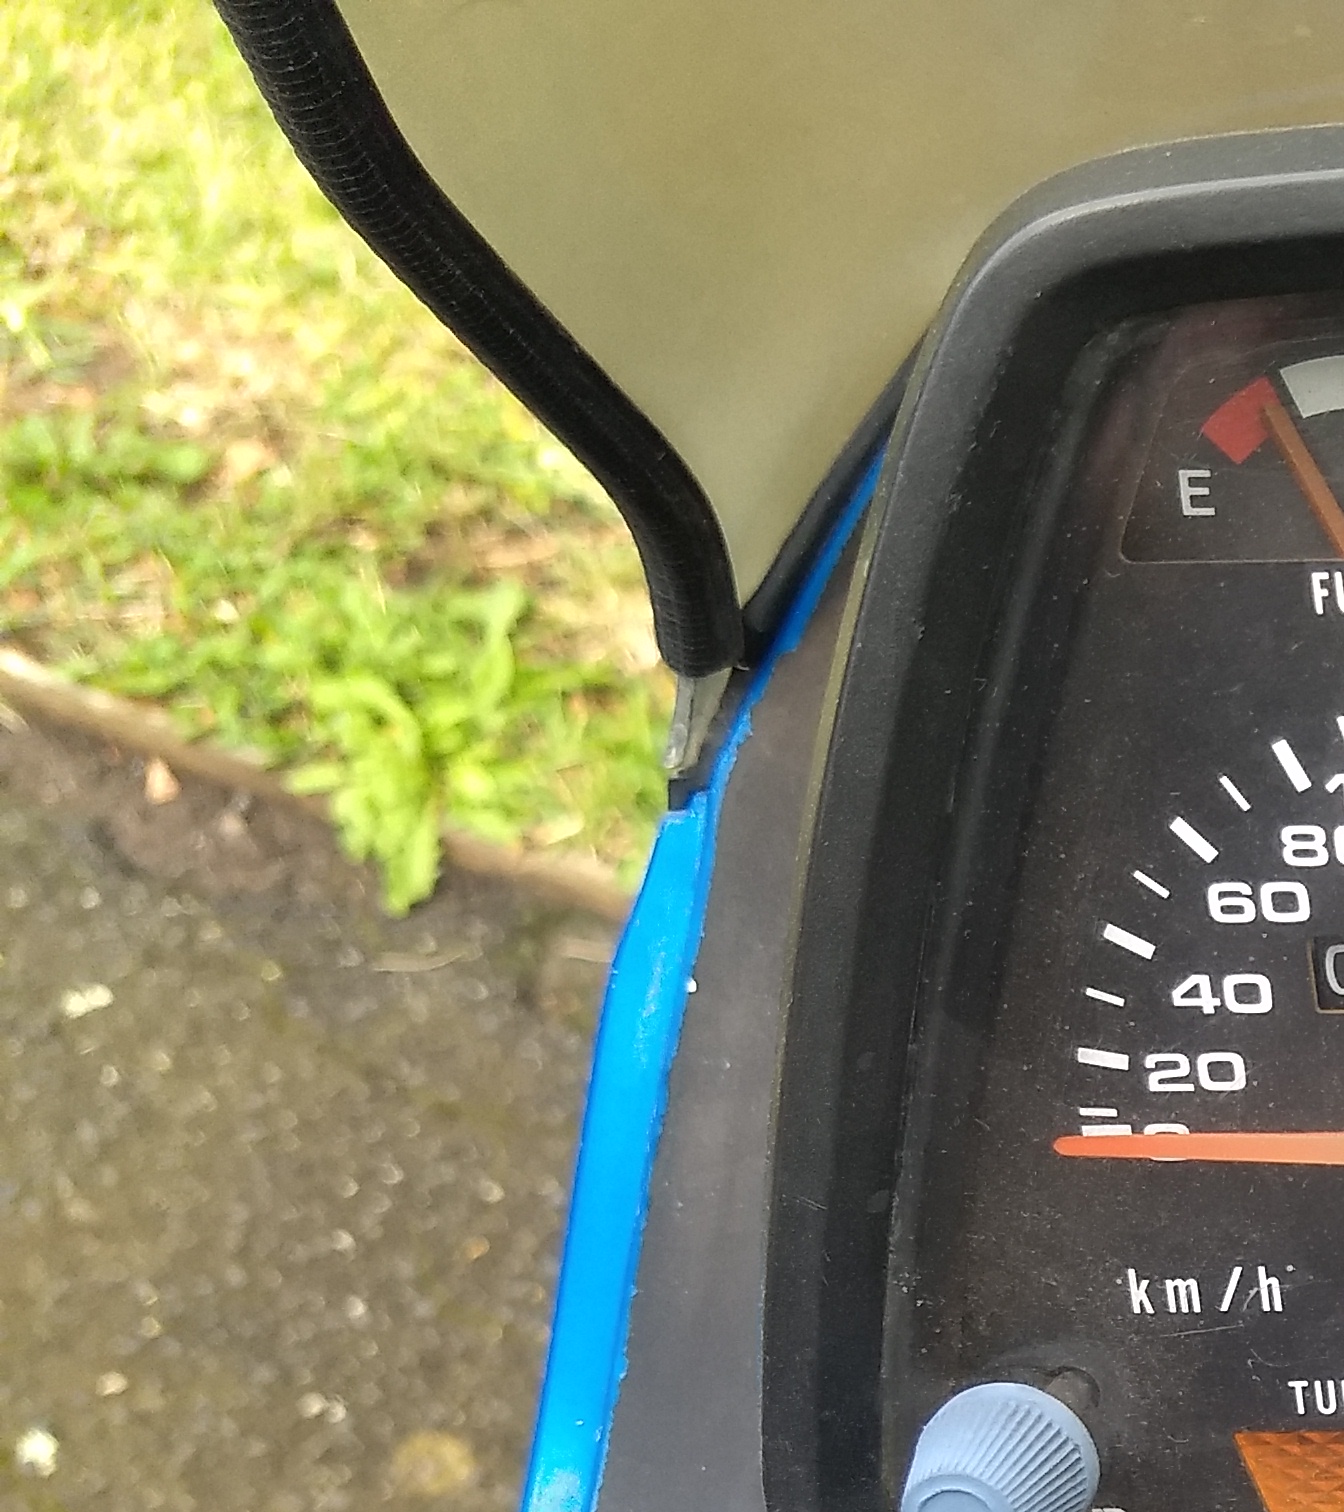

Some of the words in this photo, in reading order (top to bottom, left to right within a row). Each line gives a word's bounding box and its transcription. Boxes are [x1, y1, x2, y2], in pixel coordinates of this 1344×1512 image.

[1178, 469, 1216, 516] E
[1207, 881, 1311, 924] 60
[1171, 973, 1273, 1015] 40
[1144, 1051, 1247, 1092] 20
[1127, 1268, 1282, 1314] km/h
